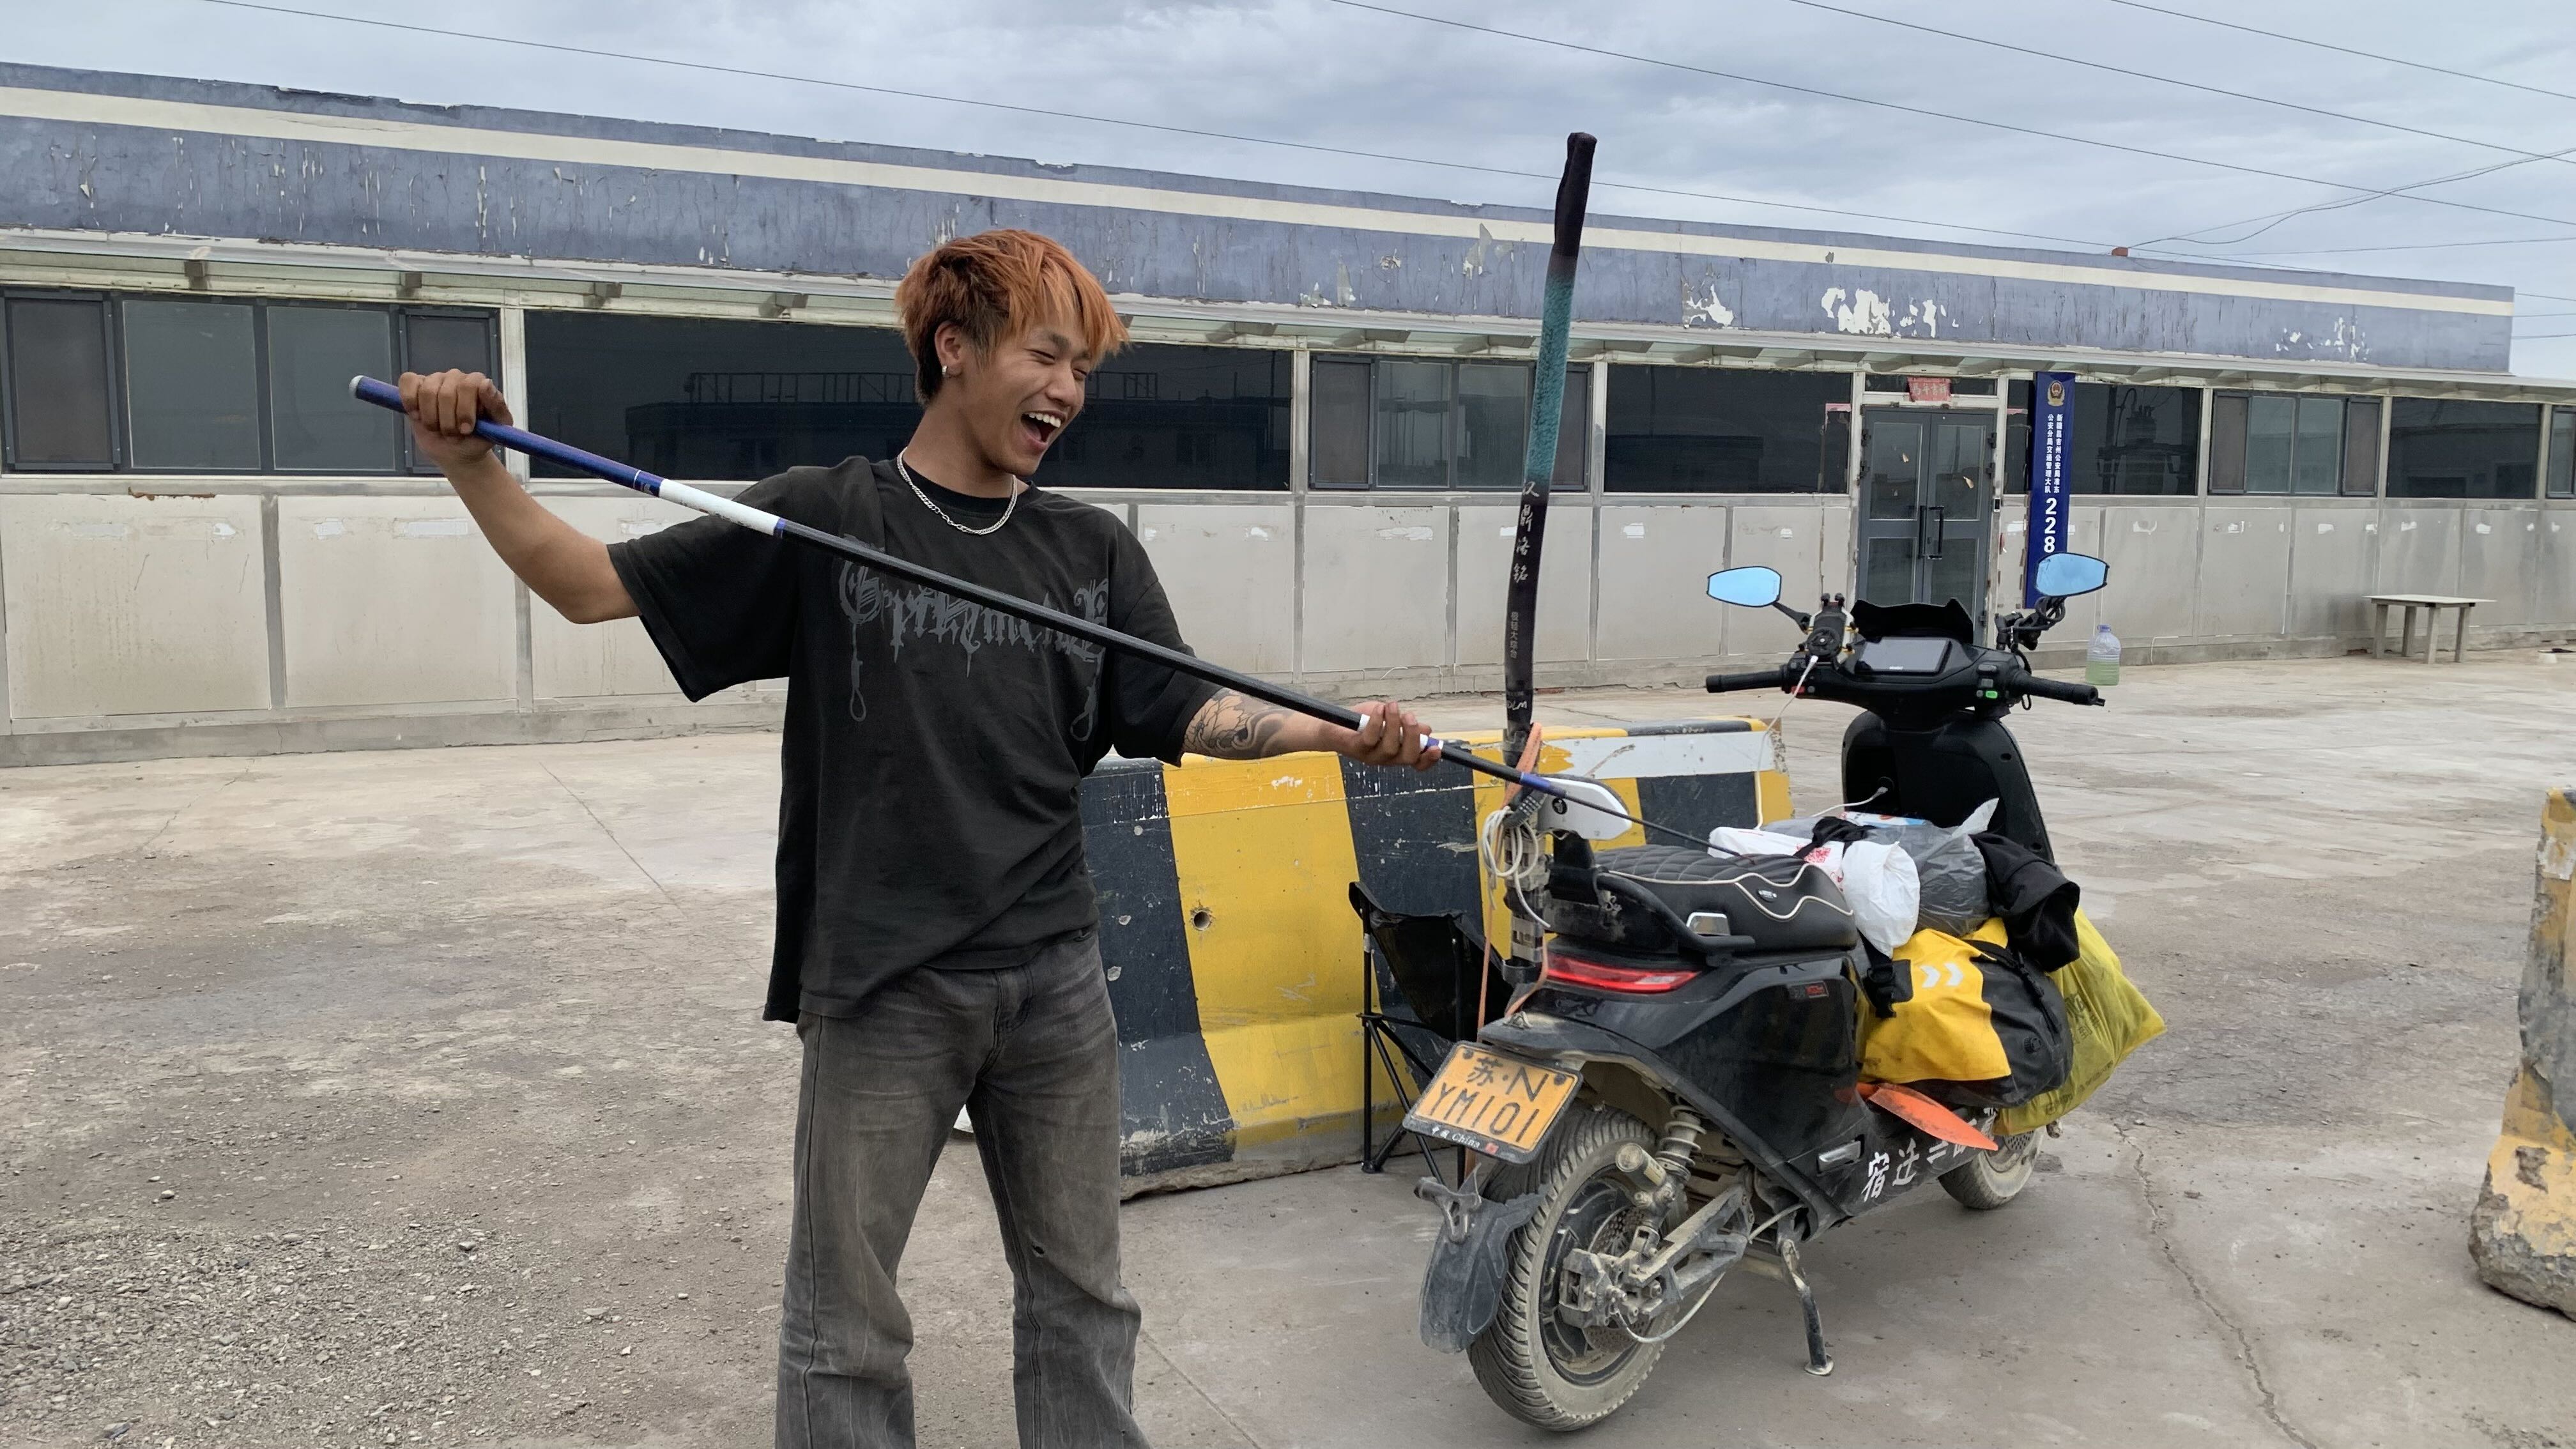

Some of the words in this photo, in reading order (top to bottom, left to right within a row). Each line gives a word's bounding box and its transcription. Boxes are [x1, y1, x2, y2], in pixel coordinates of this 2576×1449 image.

[2044, 414, 2054, 493] 公安分局交通管理大队
[2044, 497, 2057, 553] 228
[1429, 1082, 1540, 1142] YM101
[1452, 1133, 1480, 1149] China
